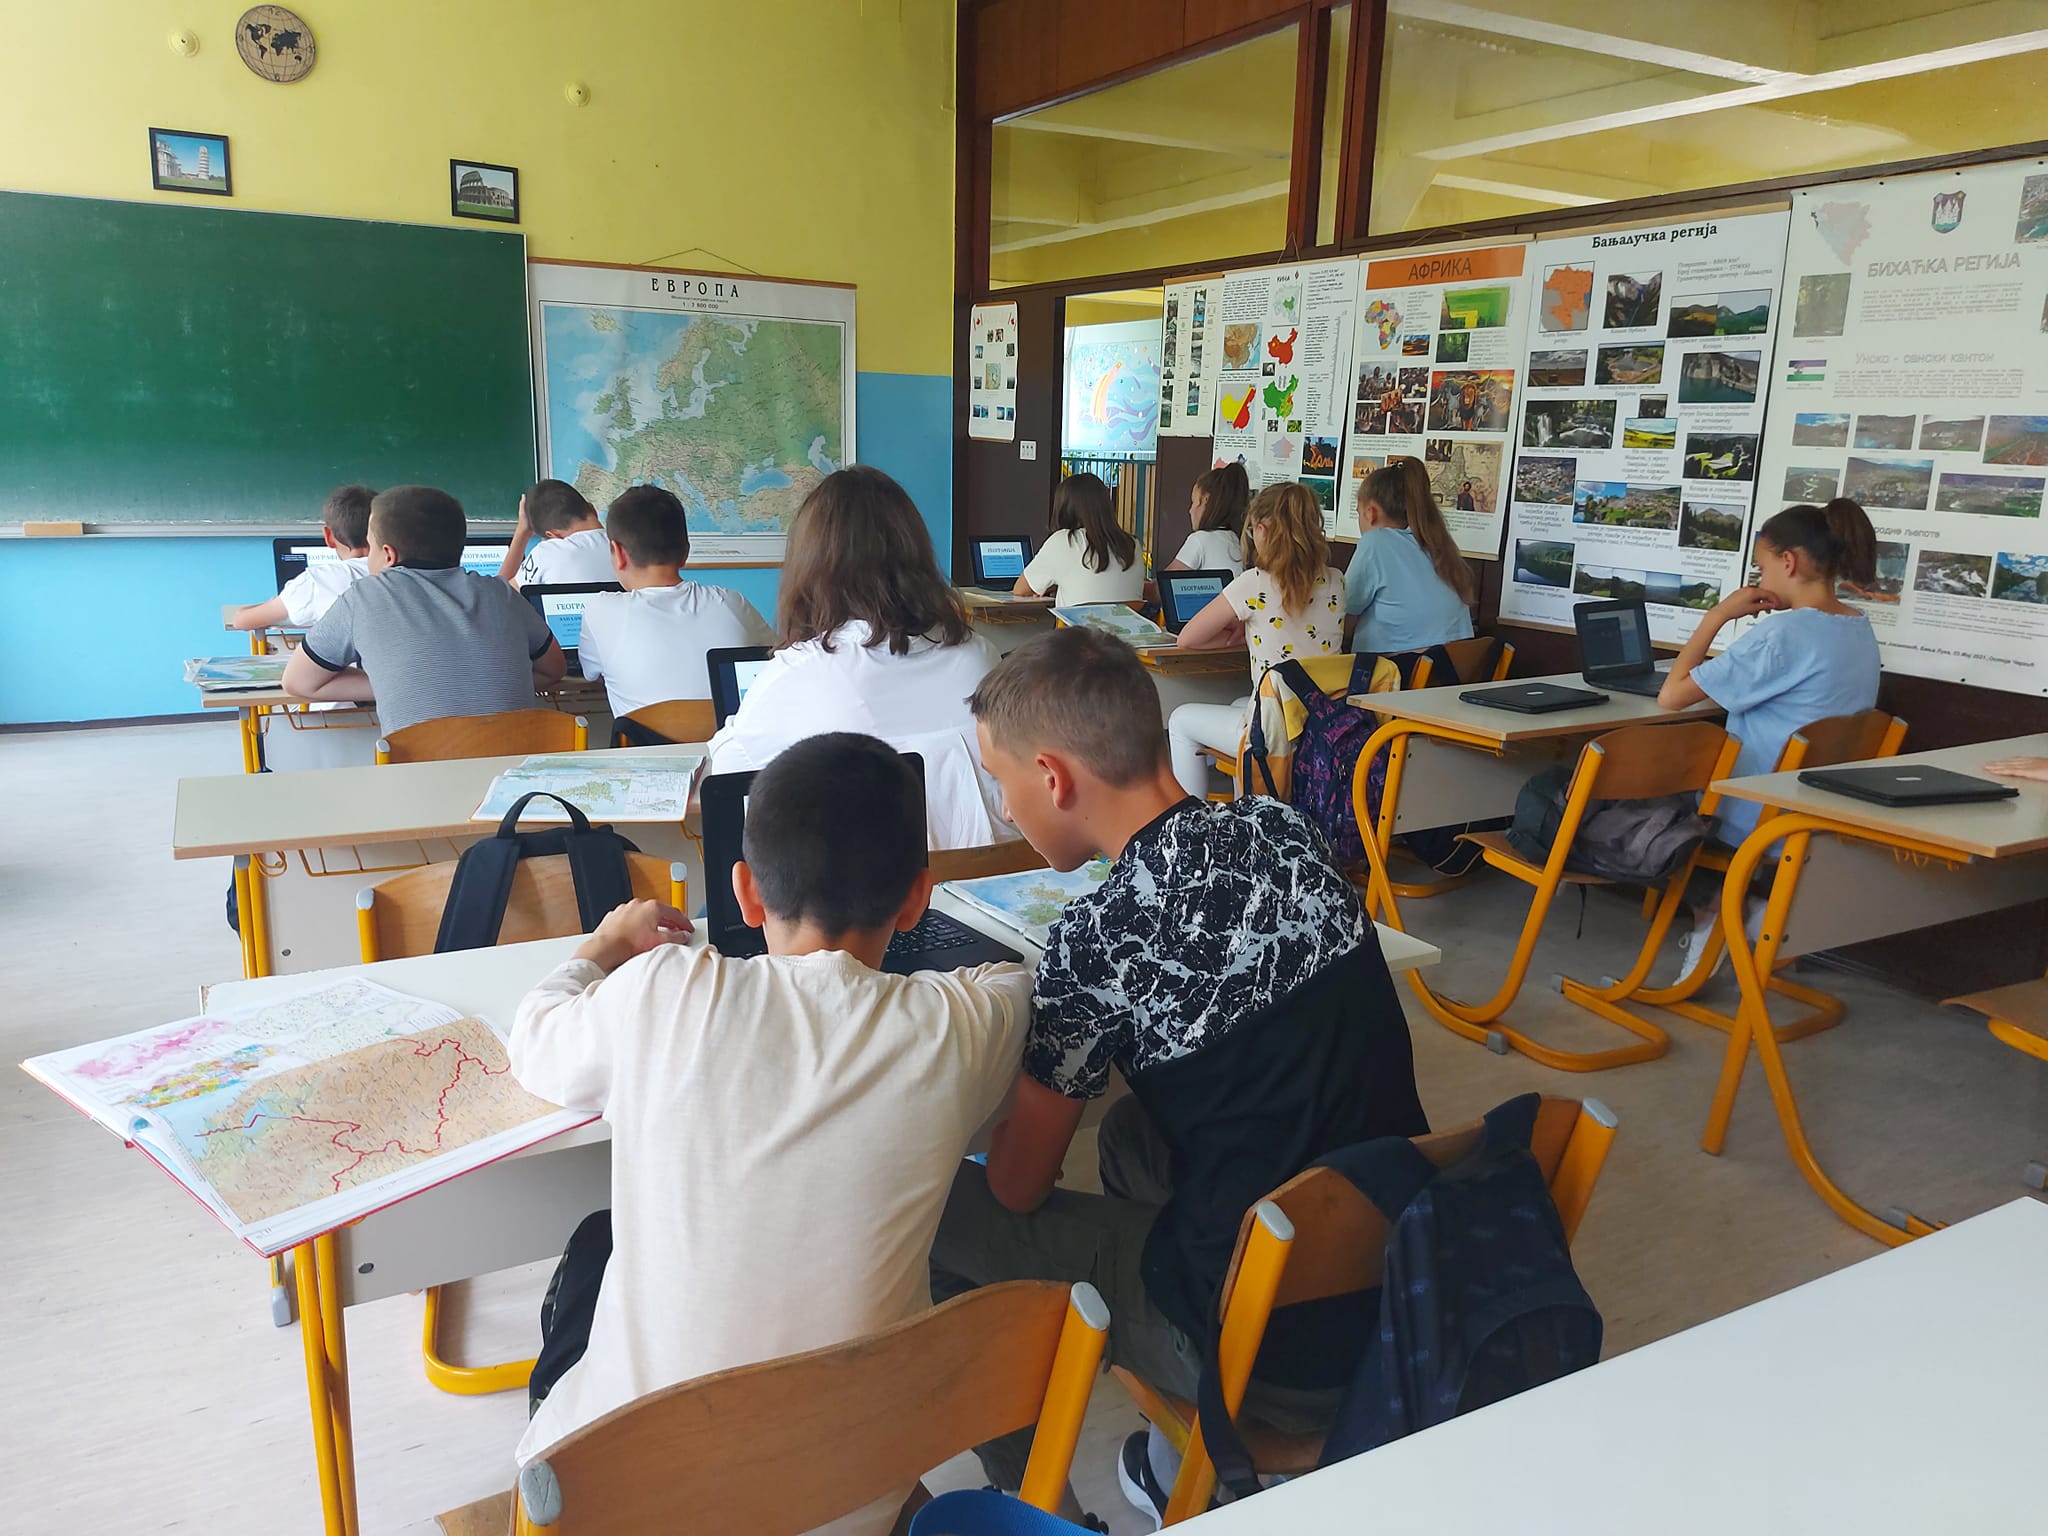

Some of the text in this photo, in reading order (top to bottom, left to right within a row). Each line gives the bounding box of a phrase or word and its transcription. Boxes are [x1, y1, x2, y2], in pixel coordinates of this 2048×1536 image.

[1591, 222, 1718, 248] Бањалучка регија
[1408, 257, 1472, 281] АФРИКА
[1867, 252, 2021, 278] БИХАЋКА РЕГИЈА
[651, 278, 739, 298] ЕВРОПА
[1873, 526, 1902, 536] родне
[463, 552, 501, 560] ЕОГРАФИЈА
[556, 603, 586, 611] ГЕОГРА
